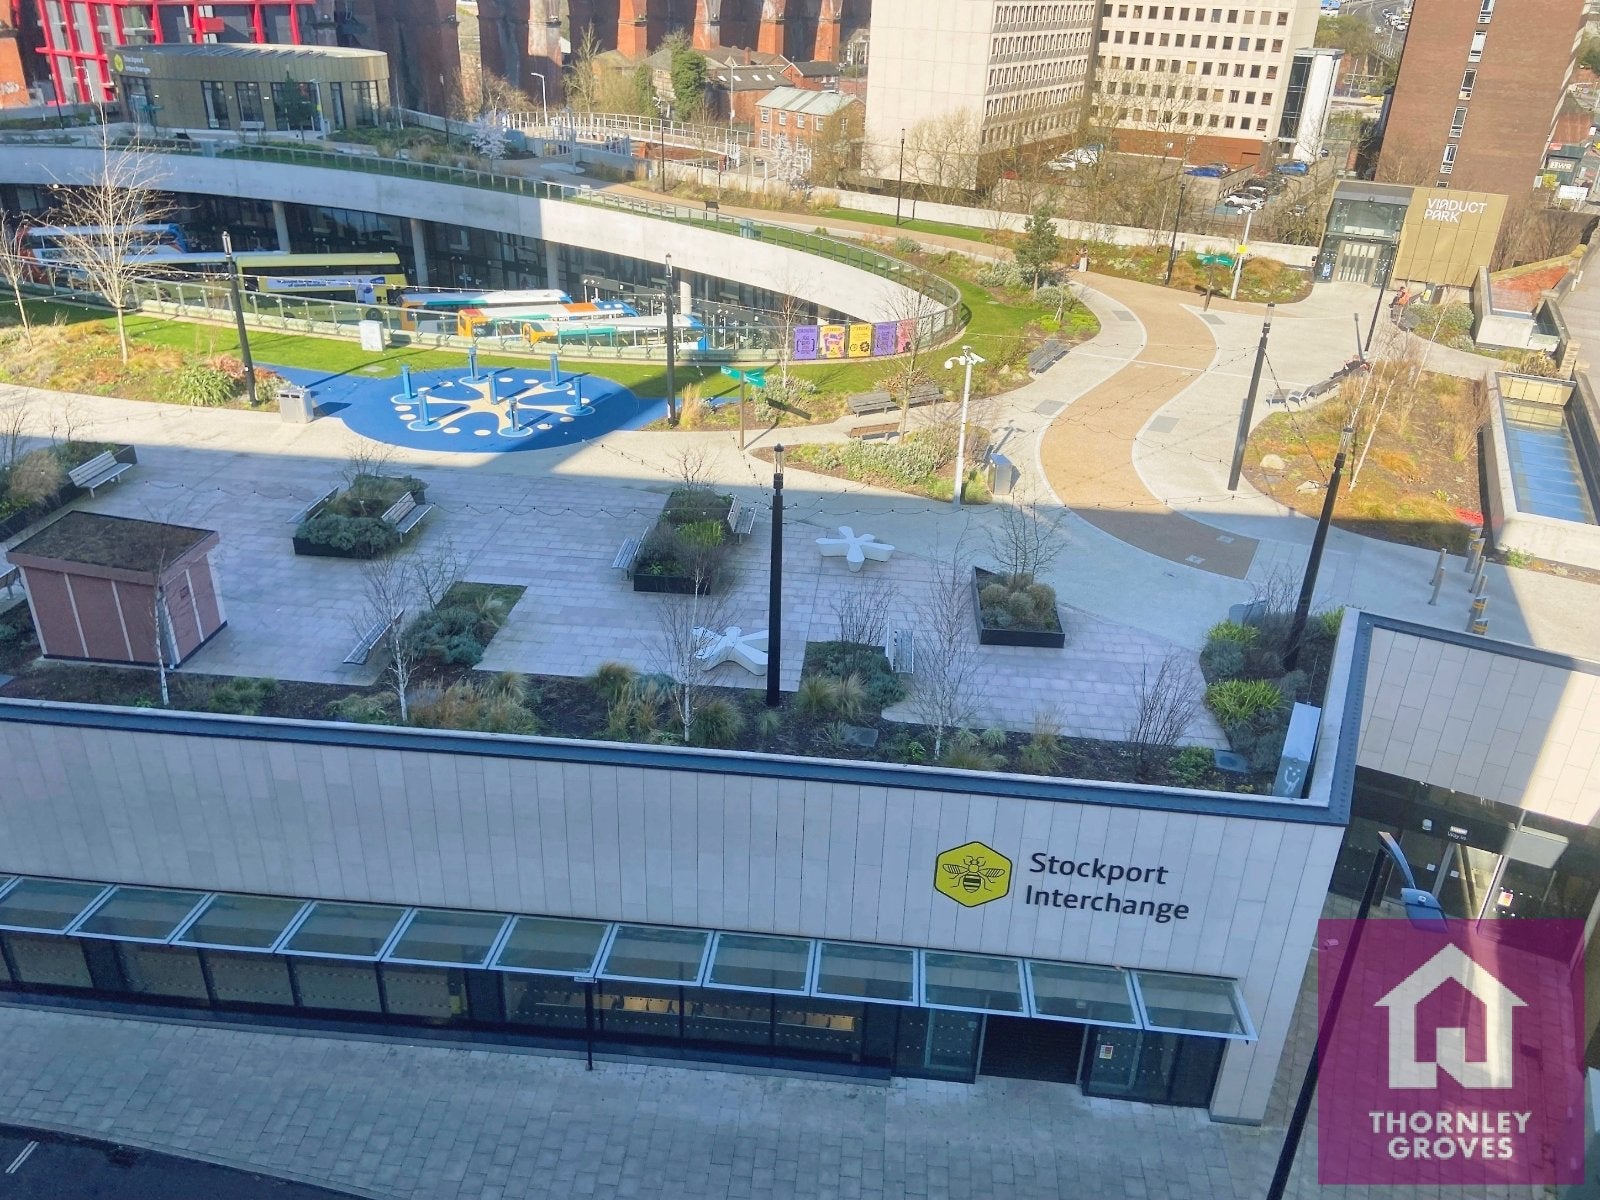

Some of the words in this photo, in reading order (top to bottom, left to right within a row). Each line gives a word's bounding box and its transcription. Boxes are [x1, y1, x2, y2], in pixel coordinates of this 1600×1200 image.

[1424, 209, 1460, 223] PARK
[1427, 198, 1488, 214] VIADUCT
[1029, 852, 1169, 885] Stockport
[1026, 885, 1190, 923] Interchange
